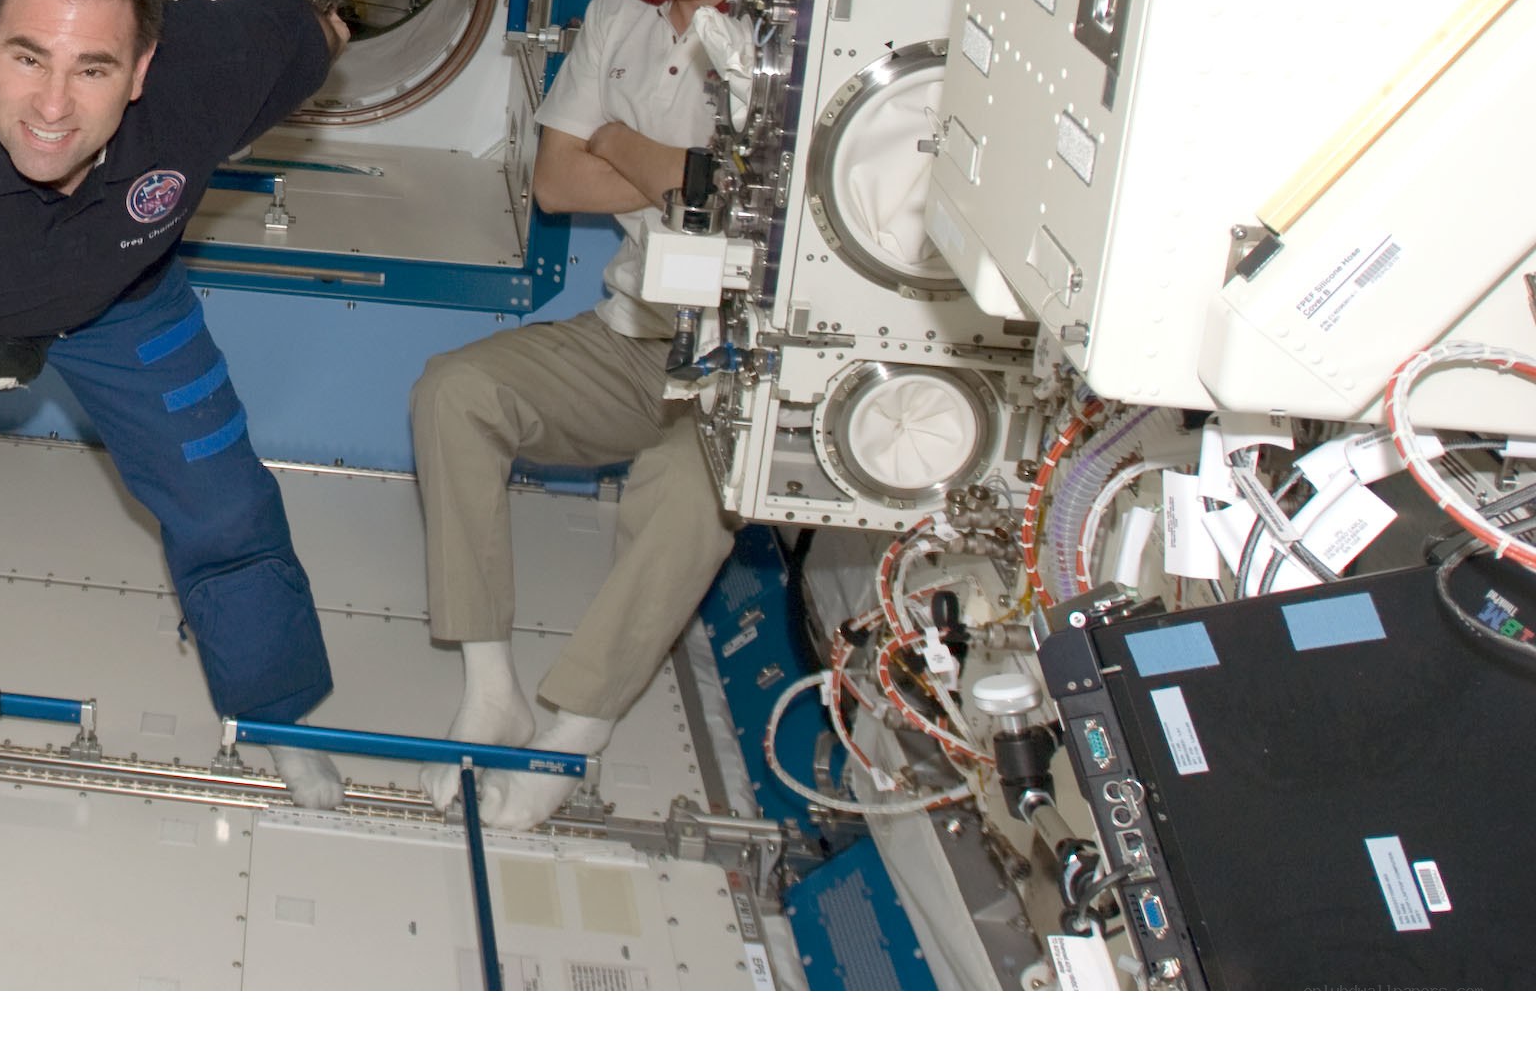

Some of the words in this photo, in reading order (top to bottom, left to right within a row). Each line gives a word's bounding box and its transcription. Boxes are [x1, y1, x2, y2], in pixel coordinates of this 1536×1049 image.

[120, 238, 144, 249] Greg
[1296, 291, 1315, 311] FPEF
[1314, 265, 1343, 293] Silicone
[1341, 248, 1361, 266] Hose
[1302, 296, 1324, 316] Cover
[1477, 601, 1535, 641] IBM
